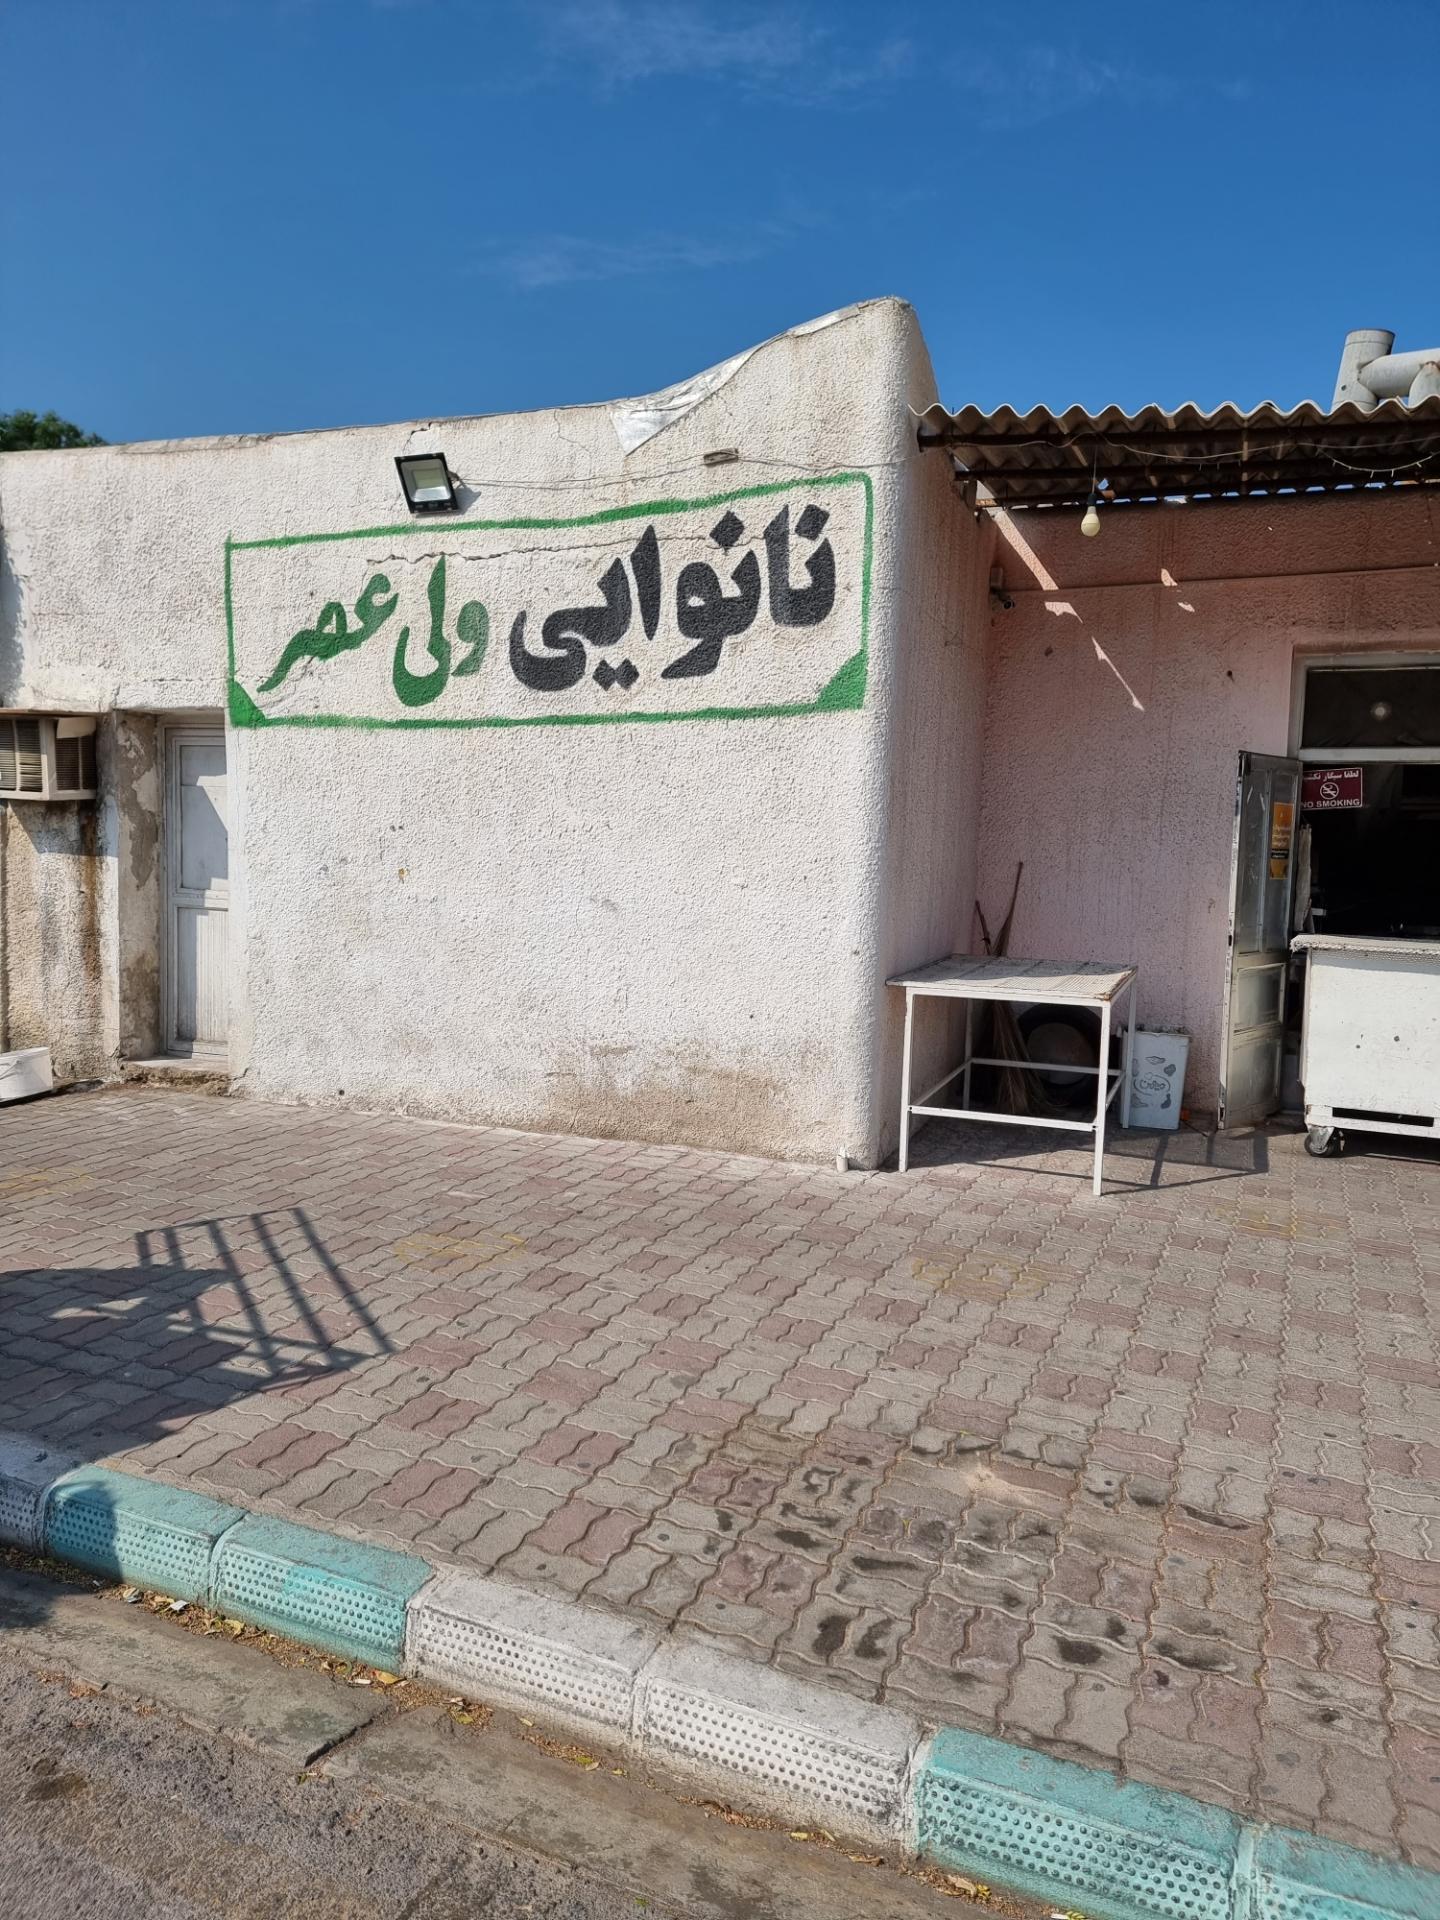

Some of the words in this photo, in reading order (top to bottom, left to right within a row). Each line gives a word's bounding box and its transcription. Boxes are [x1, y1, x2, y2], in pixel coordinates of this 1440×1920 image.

[257, 573, 399, 692] عصر
[392, 555, 490, 707] ولی
[509, 504, 836, 692] نانوایی
[1316, 798, 1361, 808] SMOKING
